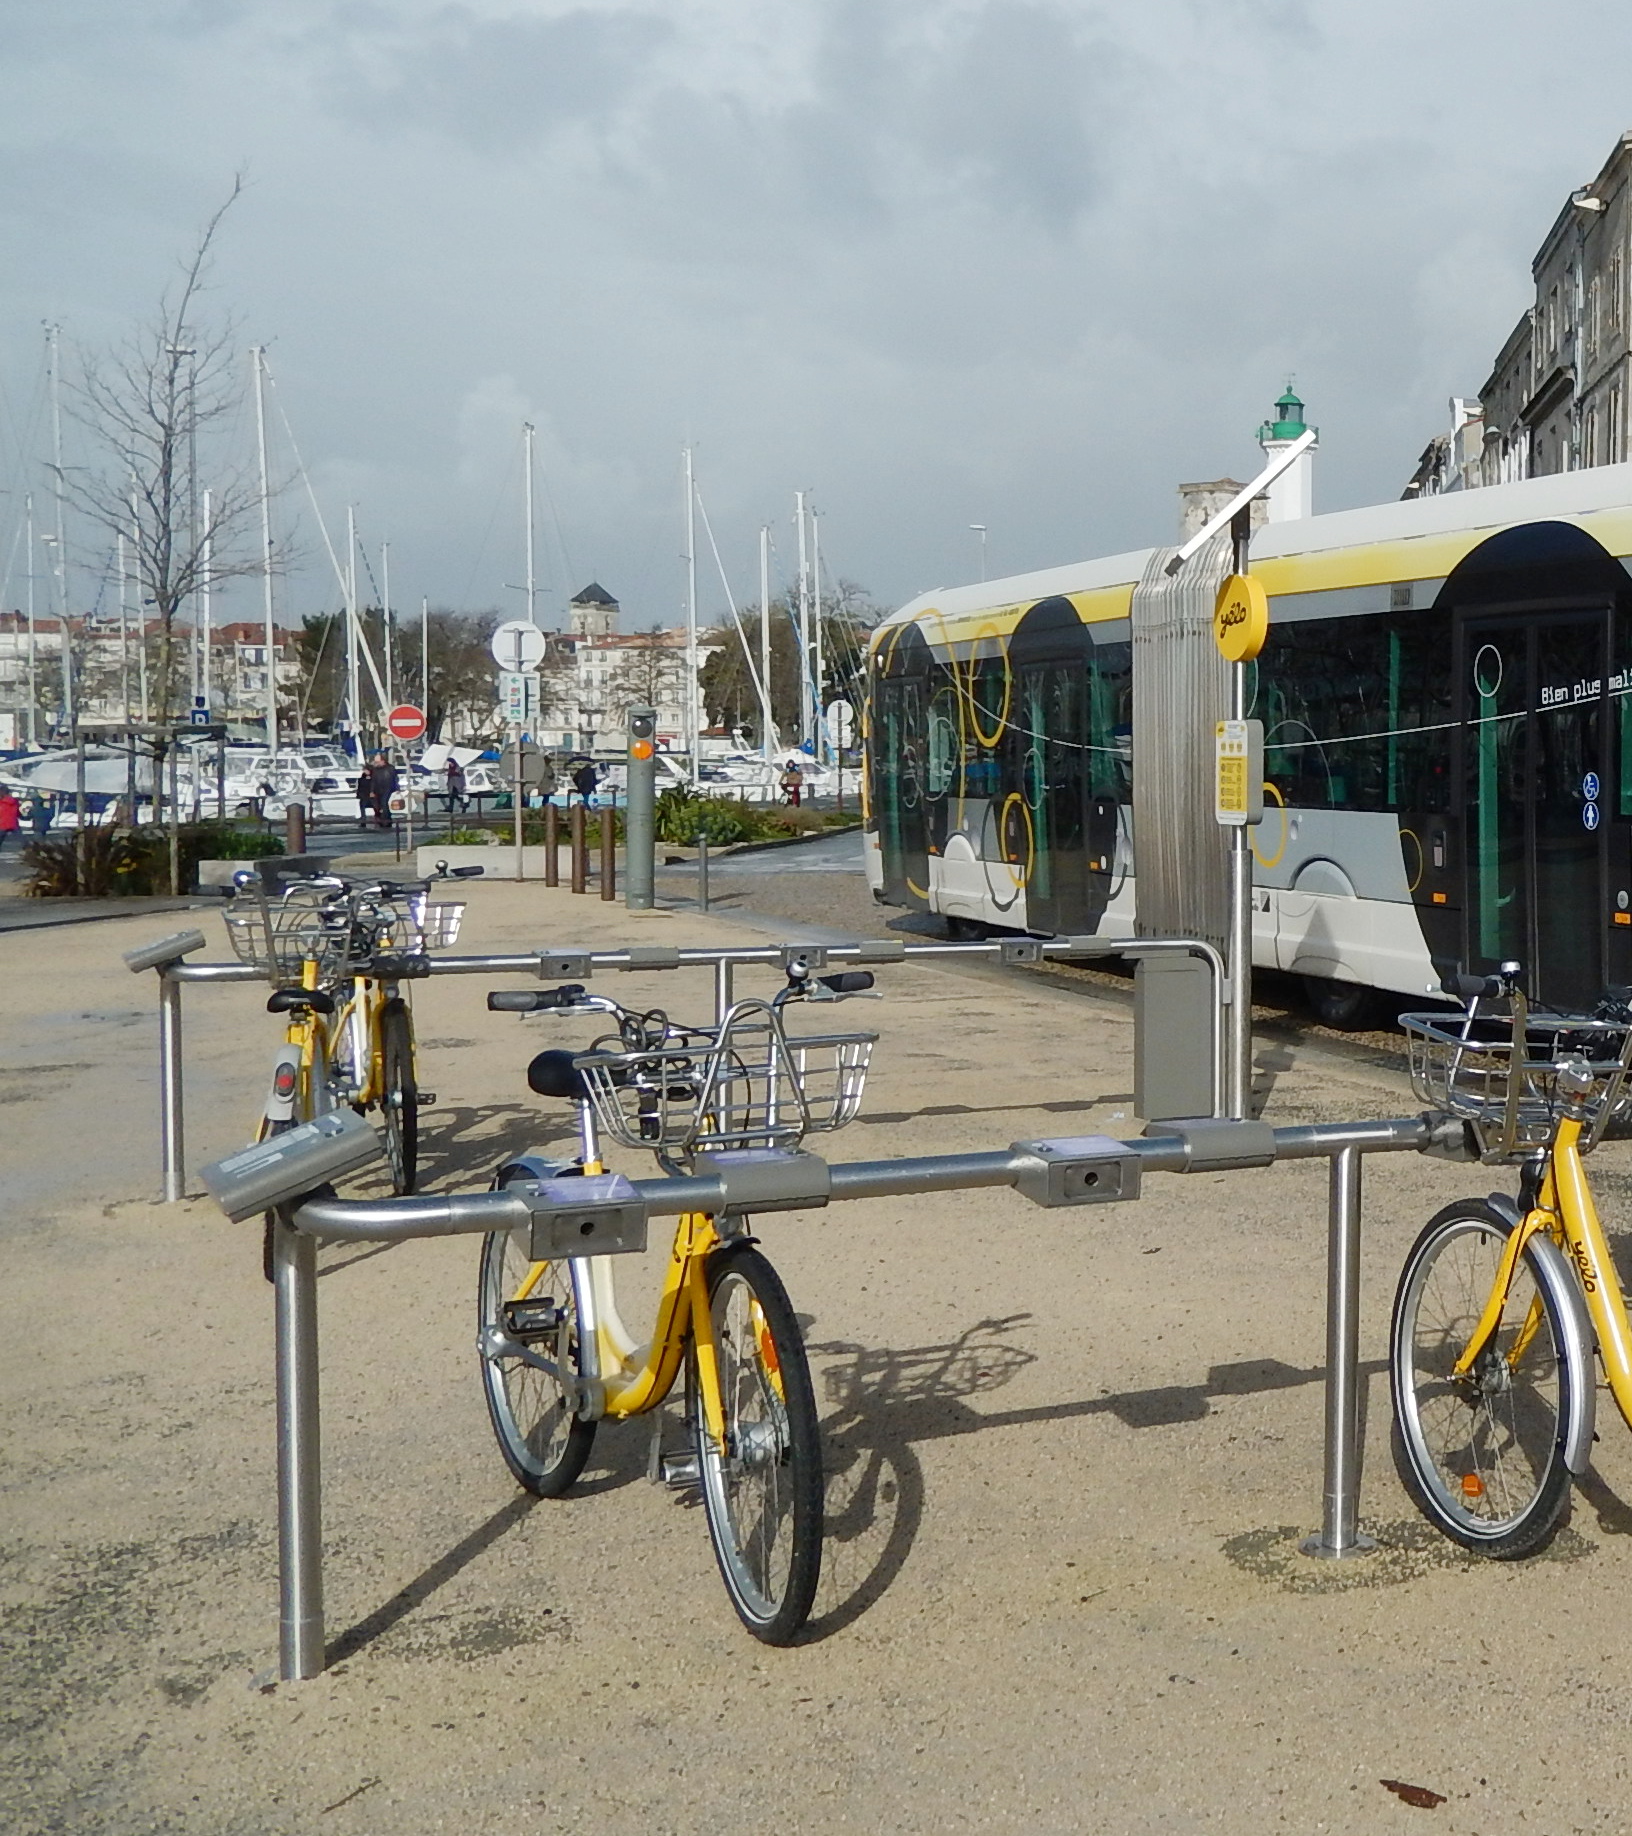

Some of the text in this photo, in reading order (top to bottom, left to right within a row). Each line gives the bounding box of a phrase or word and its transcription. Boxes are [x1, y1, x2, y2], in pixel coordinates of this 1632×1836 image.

[1219, 602, 1247, 639] yélo
[1541, 685, 1569, 705] Bien
[1573, 678, 1601, 702] plus
[1571, 1240, 1598, 1293] yélo
